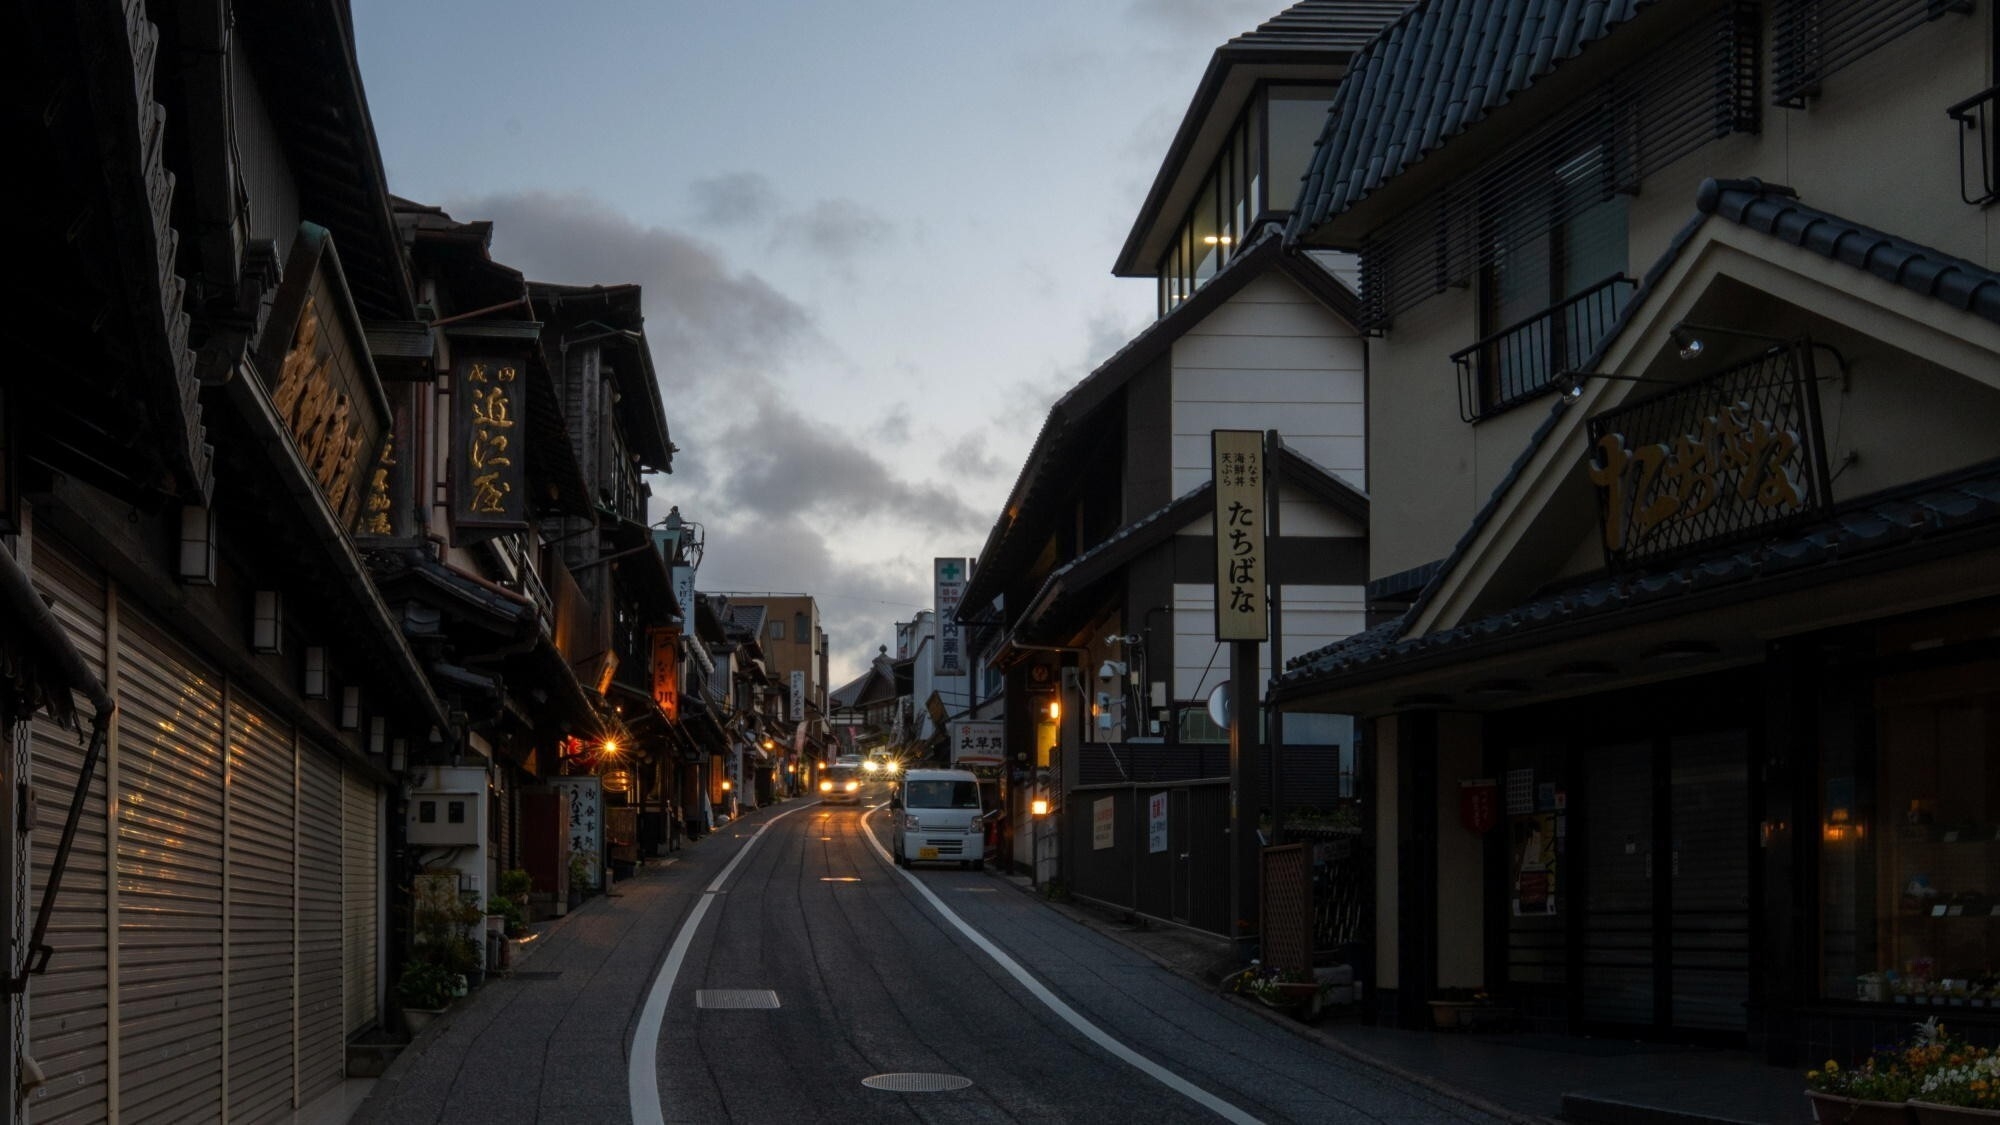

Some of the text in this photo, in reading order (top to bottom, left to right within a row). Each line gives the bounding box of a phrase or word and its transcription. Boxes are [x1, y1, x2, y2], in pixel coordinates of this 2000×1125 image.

[1221, 453, 1233, 487] 天ぷら
[1234, 453, 1245, 487] 海鮮丼
[1247, 454, 1258, 487] うなぎ
[1228, 501, 1256, 613] たちばな
